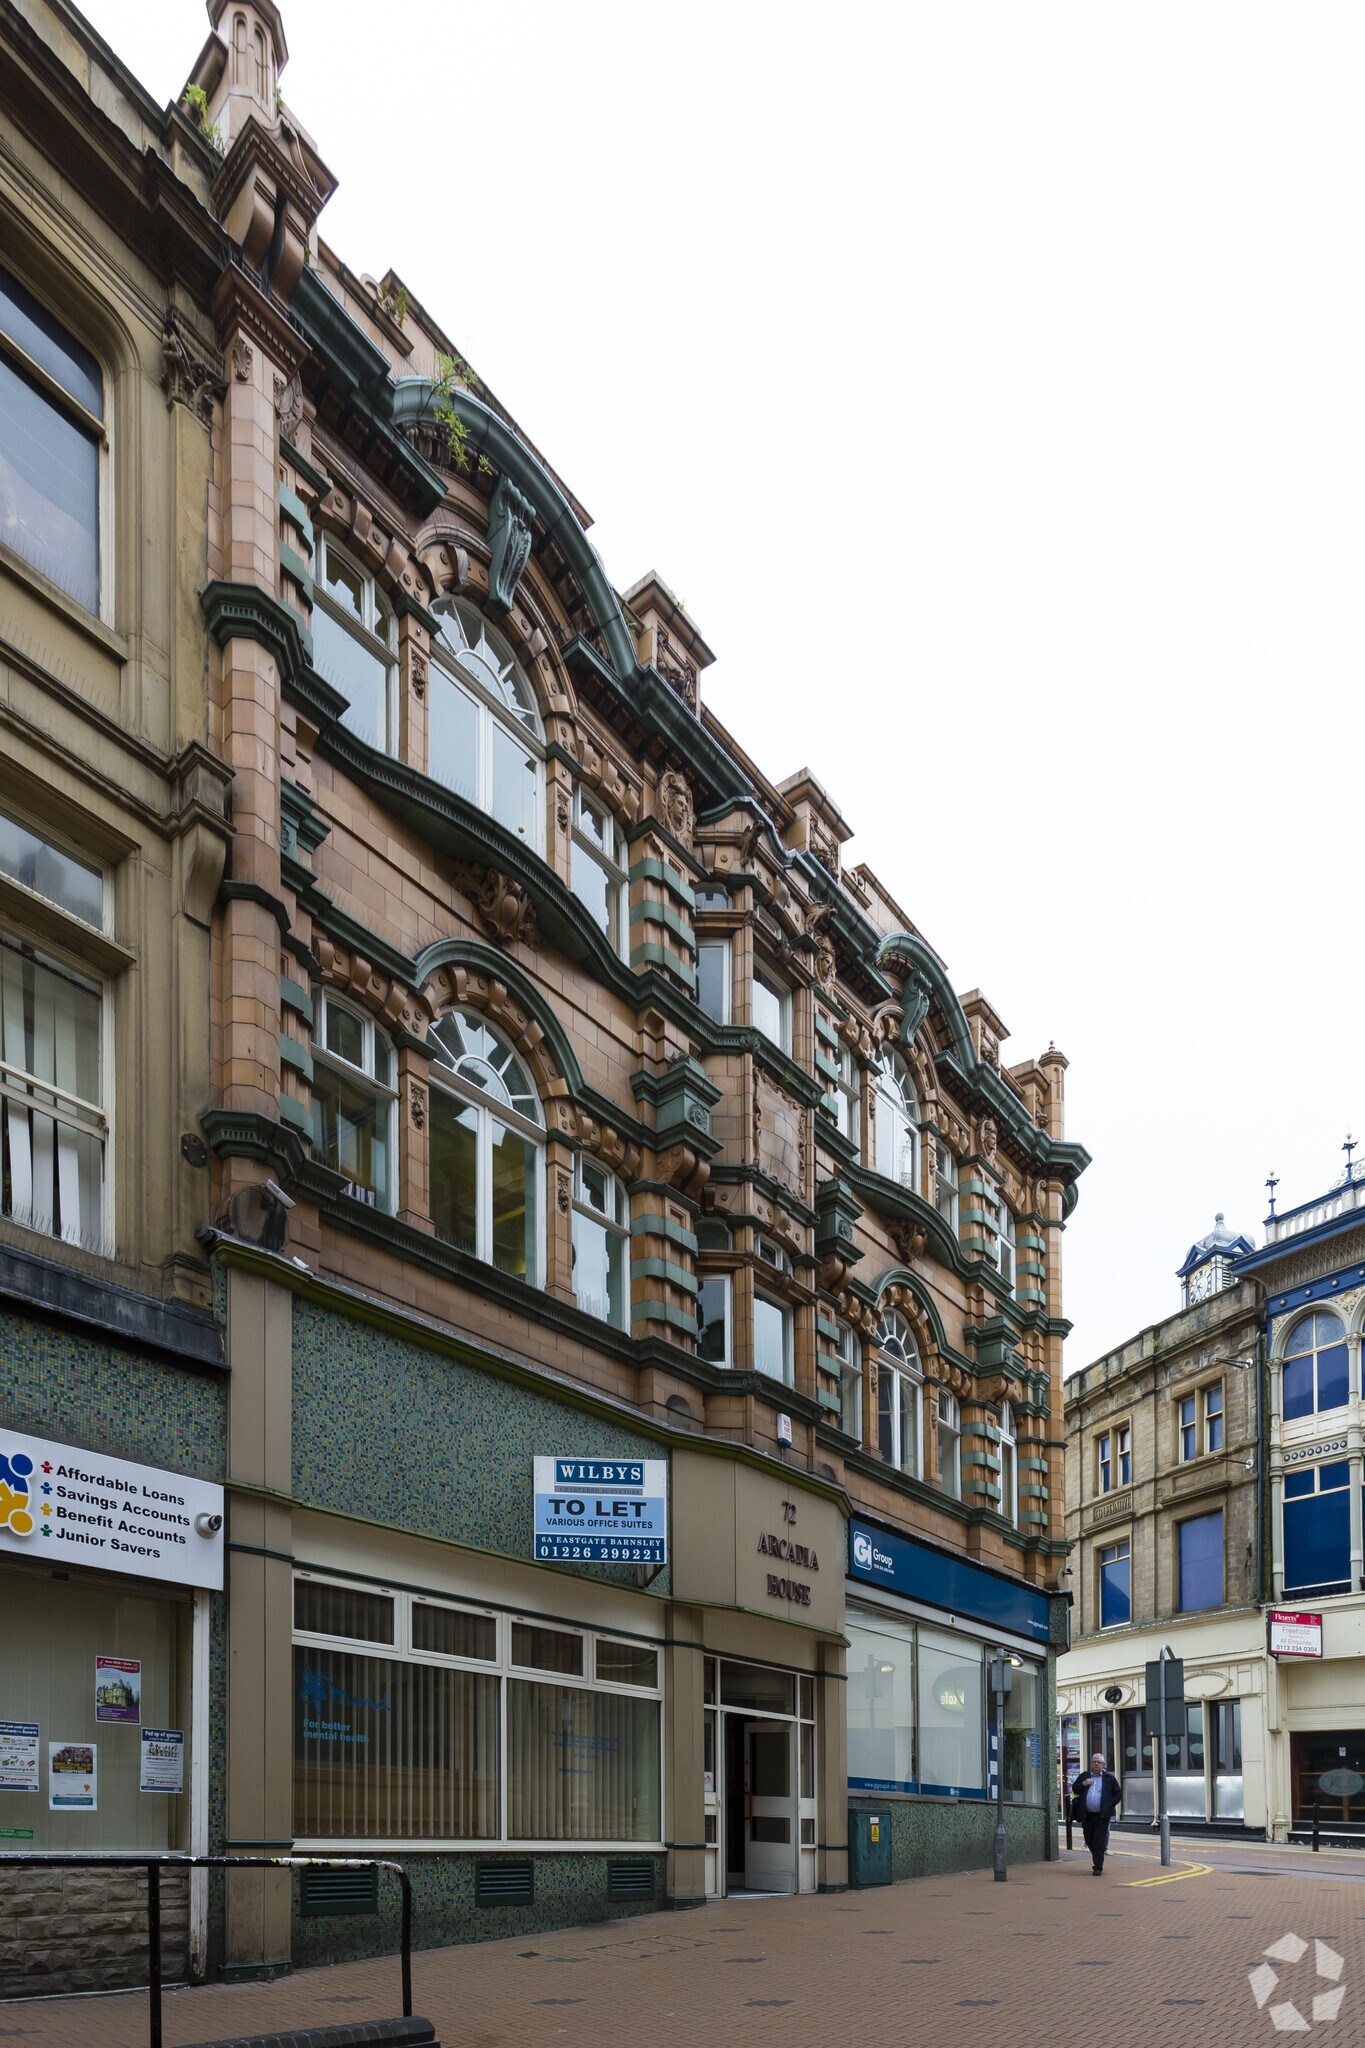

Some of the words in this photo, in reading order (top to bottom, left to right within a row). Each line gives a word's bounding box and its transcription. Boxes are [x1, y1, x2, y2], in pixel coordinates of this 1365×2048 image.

[560, 1465, 641, 1480] WILBYS
[56, 1465, 138, 1494] Affordable
[142, 1486, 185, 1506] Loans
[56, 1485, 118, 1510] Savings
[121, 1501, 190, 1526] Accounts
[548, 1499, 585, 1515] TO
[595, 1500, 647, 1517] LET
[781, 1501, 797, 1524] 72
[56, 1506, 113, 1529] Benefit
[117, 1520, 187, 1544] Accounts
[546, 1518, 585, 1527] VARIOUS
[587, 1519, 618, 1528] OFFICE
[621, 1520, 653, 1529] SUITES
[56, 1527, 105, 1547] Junior
[110, 1538, 161, 1558] Savers
[556, 1537, 606, 1545] EASTGATE
[610, 1538, 661, 1547] BARNSLEY
[757, 1531, 820, 1571] ARCADIA
[540, 1546, 591, 1558] 01226
[600, 1548, 661, 1560] 299221
[873, 1548, 892, 1568] Group
[767, 1573, 811, 1605] HOUSE
[1274, 1613, 1297, 1621] Fleurets
[1282, 1627, 1310, 1635] Freehold
[303, 1719, 319, 1728] For
[322, 1721, 351, 1731] better
[303, 1731, 337, 1740] mental
[340, 1733, 369, 1743] health
